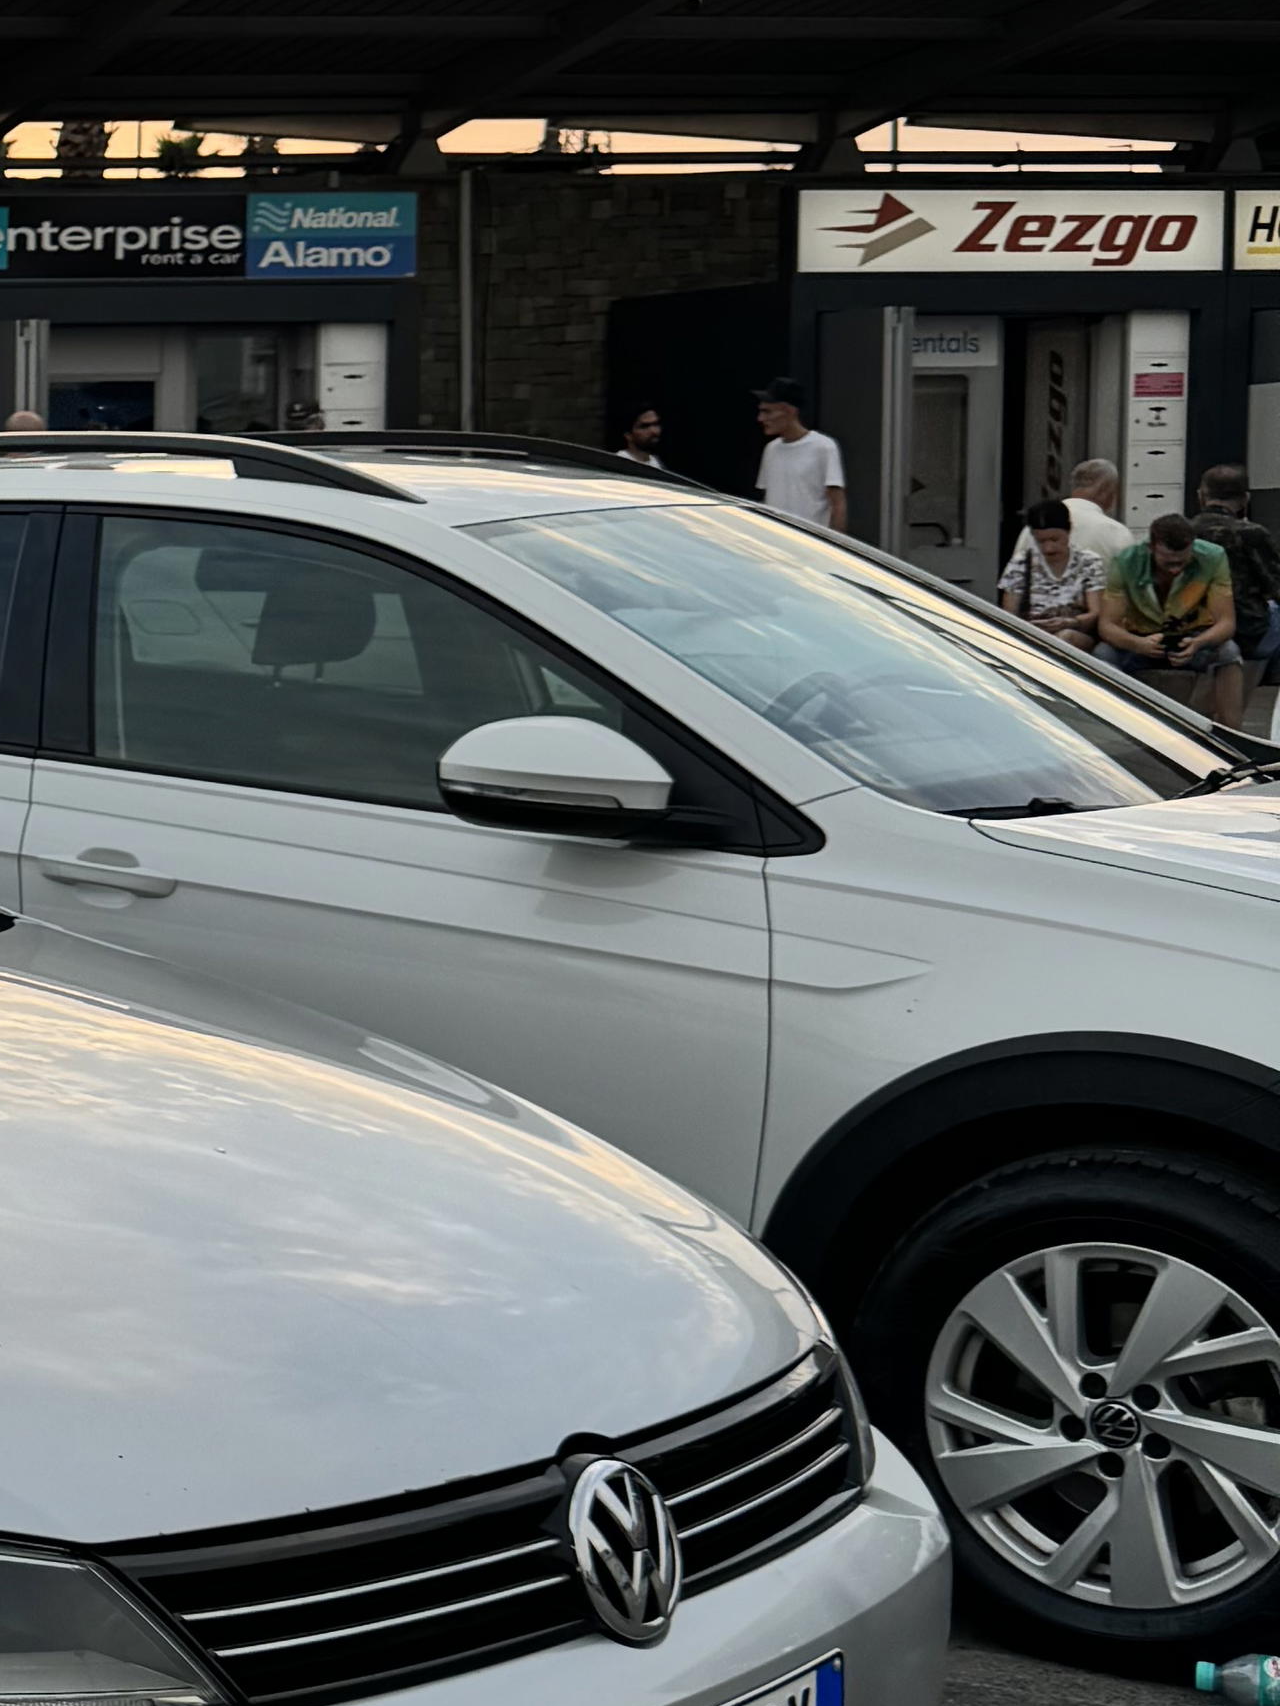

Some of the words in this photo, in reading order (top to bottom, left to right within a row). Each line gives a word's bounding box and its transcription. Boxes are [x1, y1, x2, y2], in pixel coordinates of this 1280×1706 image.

[291, 207, 399, 229] National
[952, 201, 1198, 266] Zezgo
[141, 252, 185, 266] rent
[190, 254, 203, 265] a
[208, 253, 241, 265] car
[258, 241, 392, 268] Alamo
